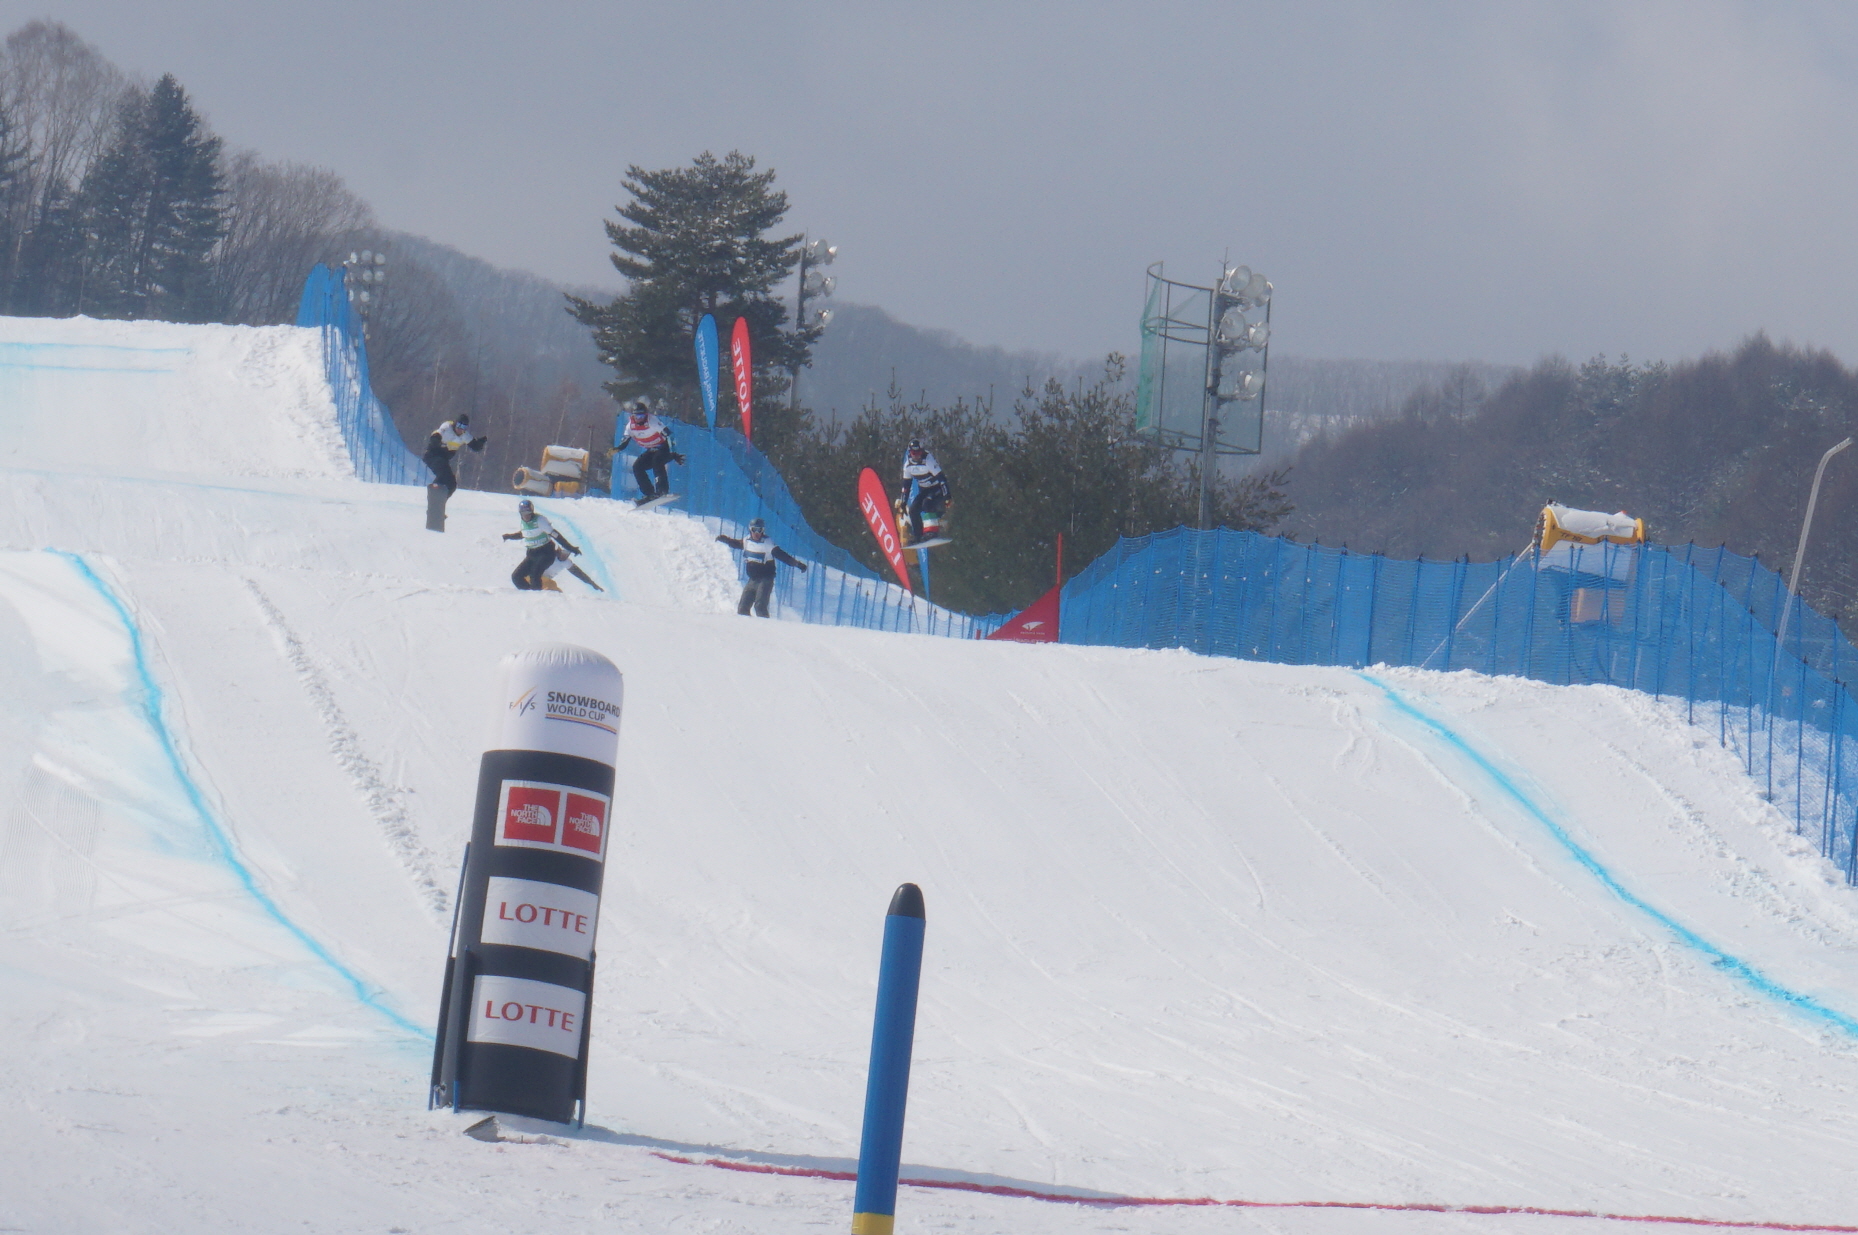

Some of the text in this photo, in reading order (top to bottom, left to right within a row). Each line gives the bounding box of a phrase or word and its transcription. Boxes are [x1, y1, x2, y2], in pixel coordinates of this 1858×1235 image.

[547, 691, 621, 718] SNOWBOARD
[547, 703, 606, 721] WORLD CUP
[511, 809, 539, 819] NORTH
[581, 812, 593, 820] THE
[569, 816, 593, 828] NORTH
[575, 825, 593, 834] FACE
[499, 902, 588, 934] LOTTE
[485, 1000, 575, 1032] LOTTE
